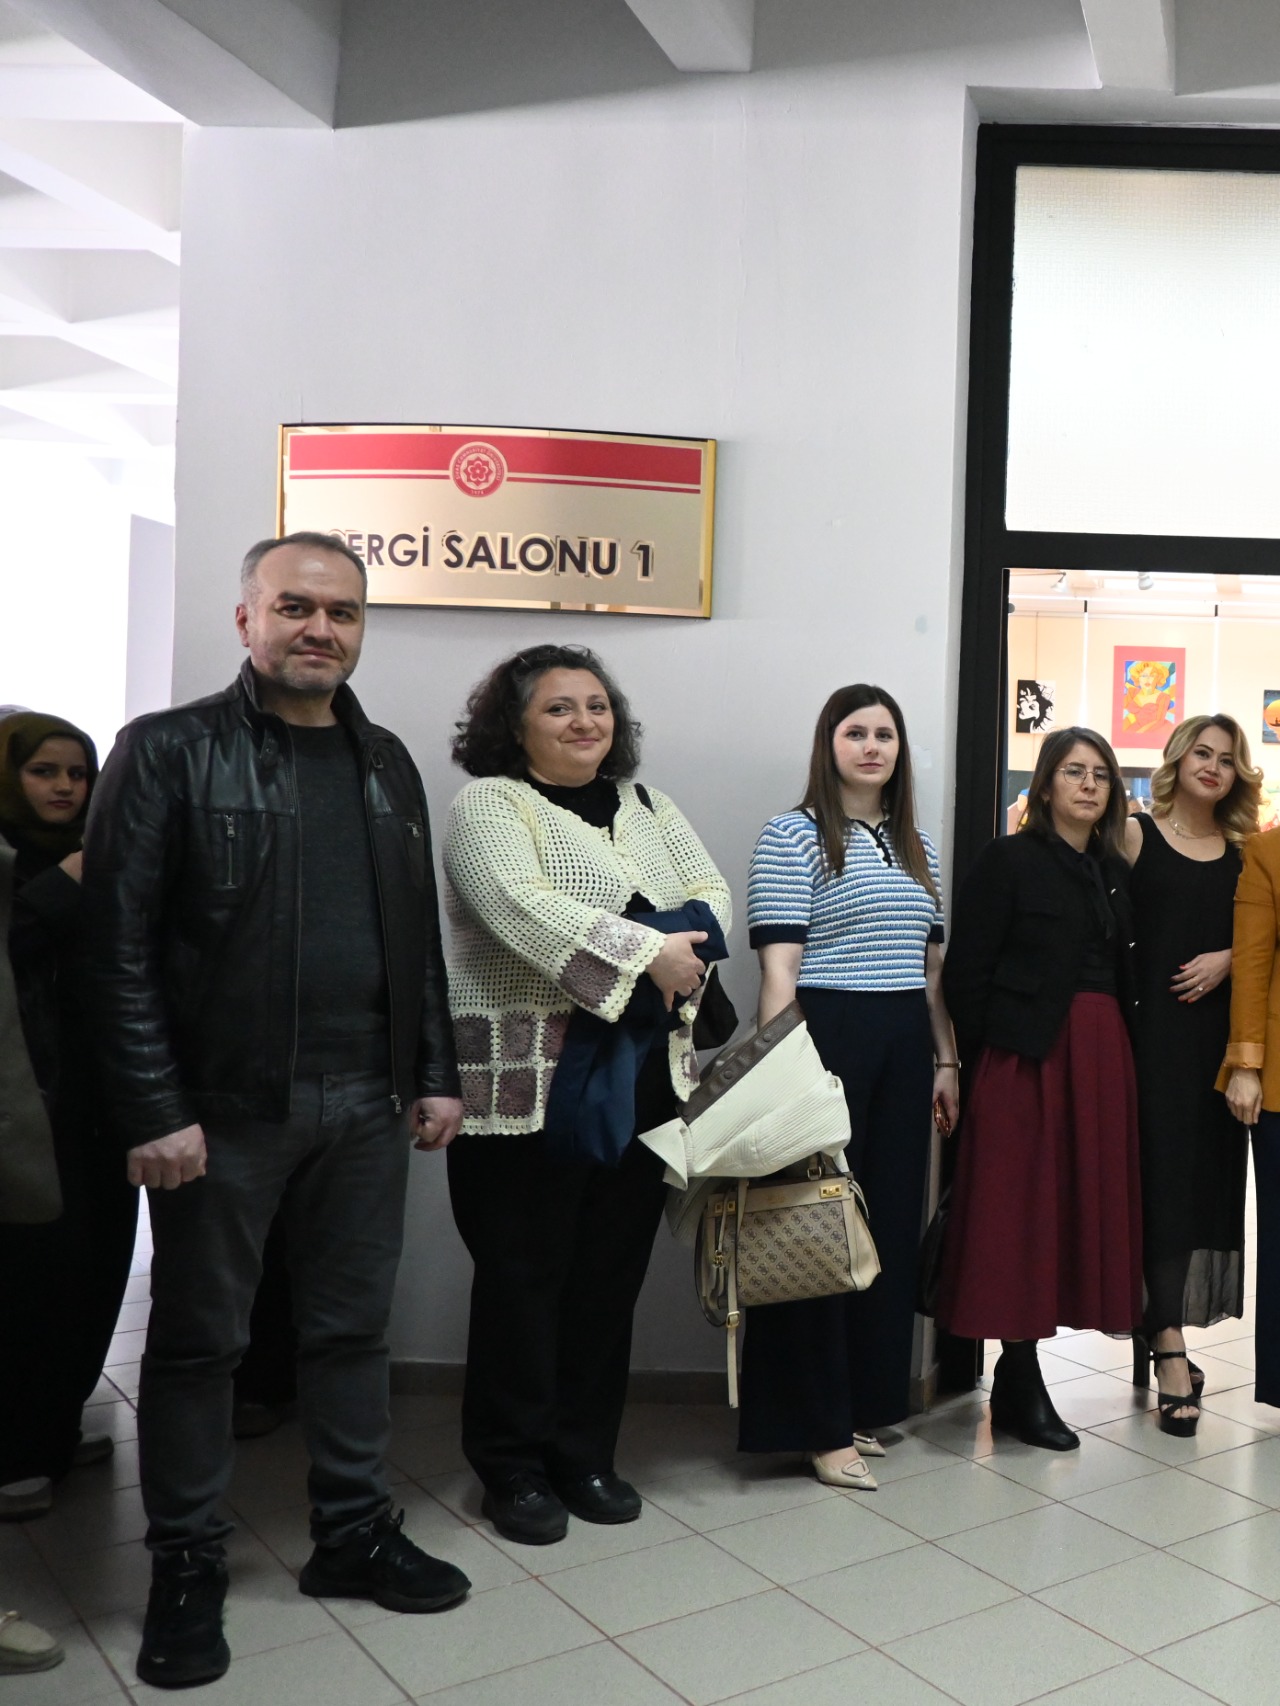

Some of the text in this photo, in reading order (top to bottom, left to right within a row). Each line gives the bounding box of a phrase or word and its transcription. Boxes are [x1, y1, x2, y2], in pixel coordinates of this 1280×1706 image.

[331, 526, 651, 577] ERGİ SALONU 1
